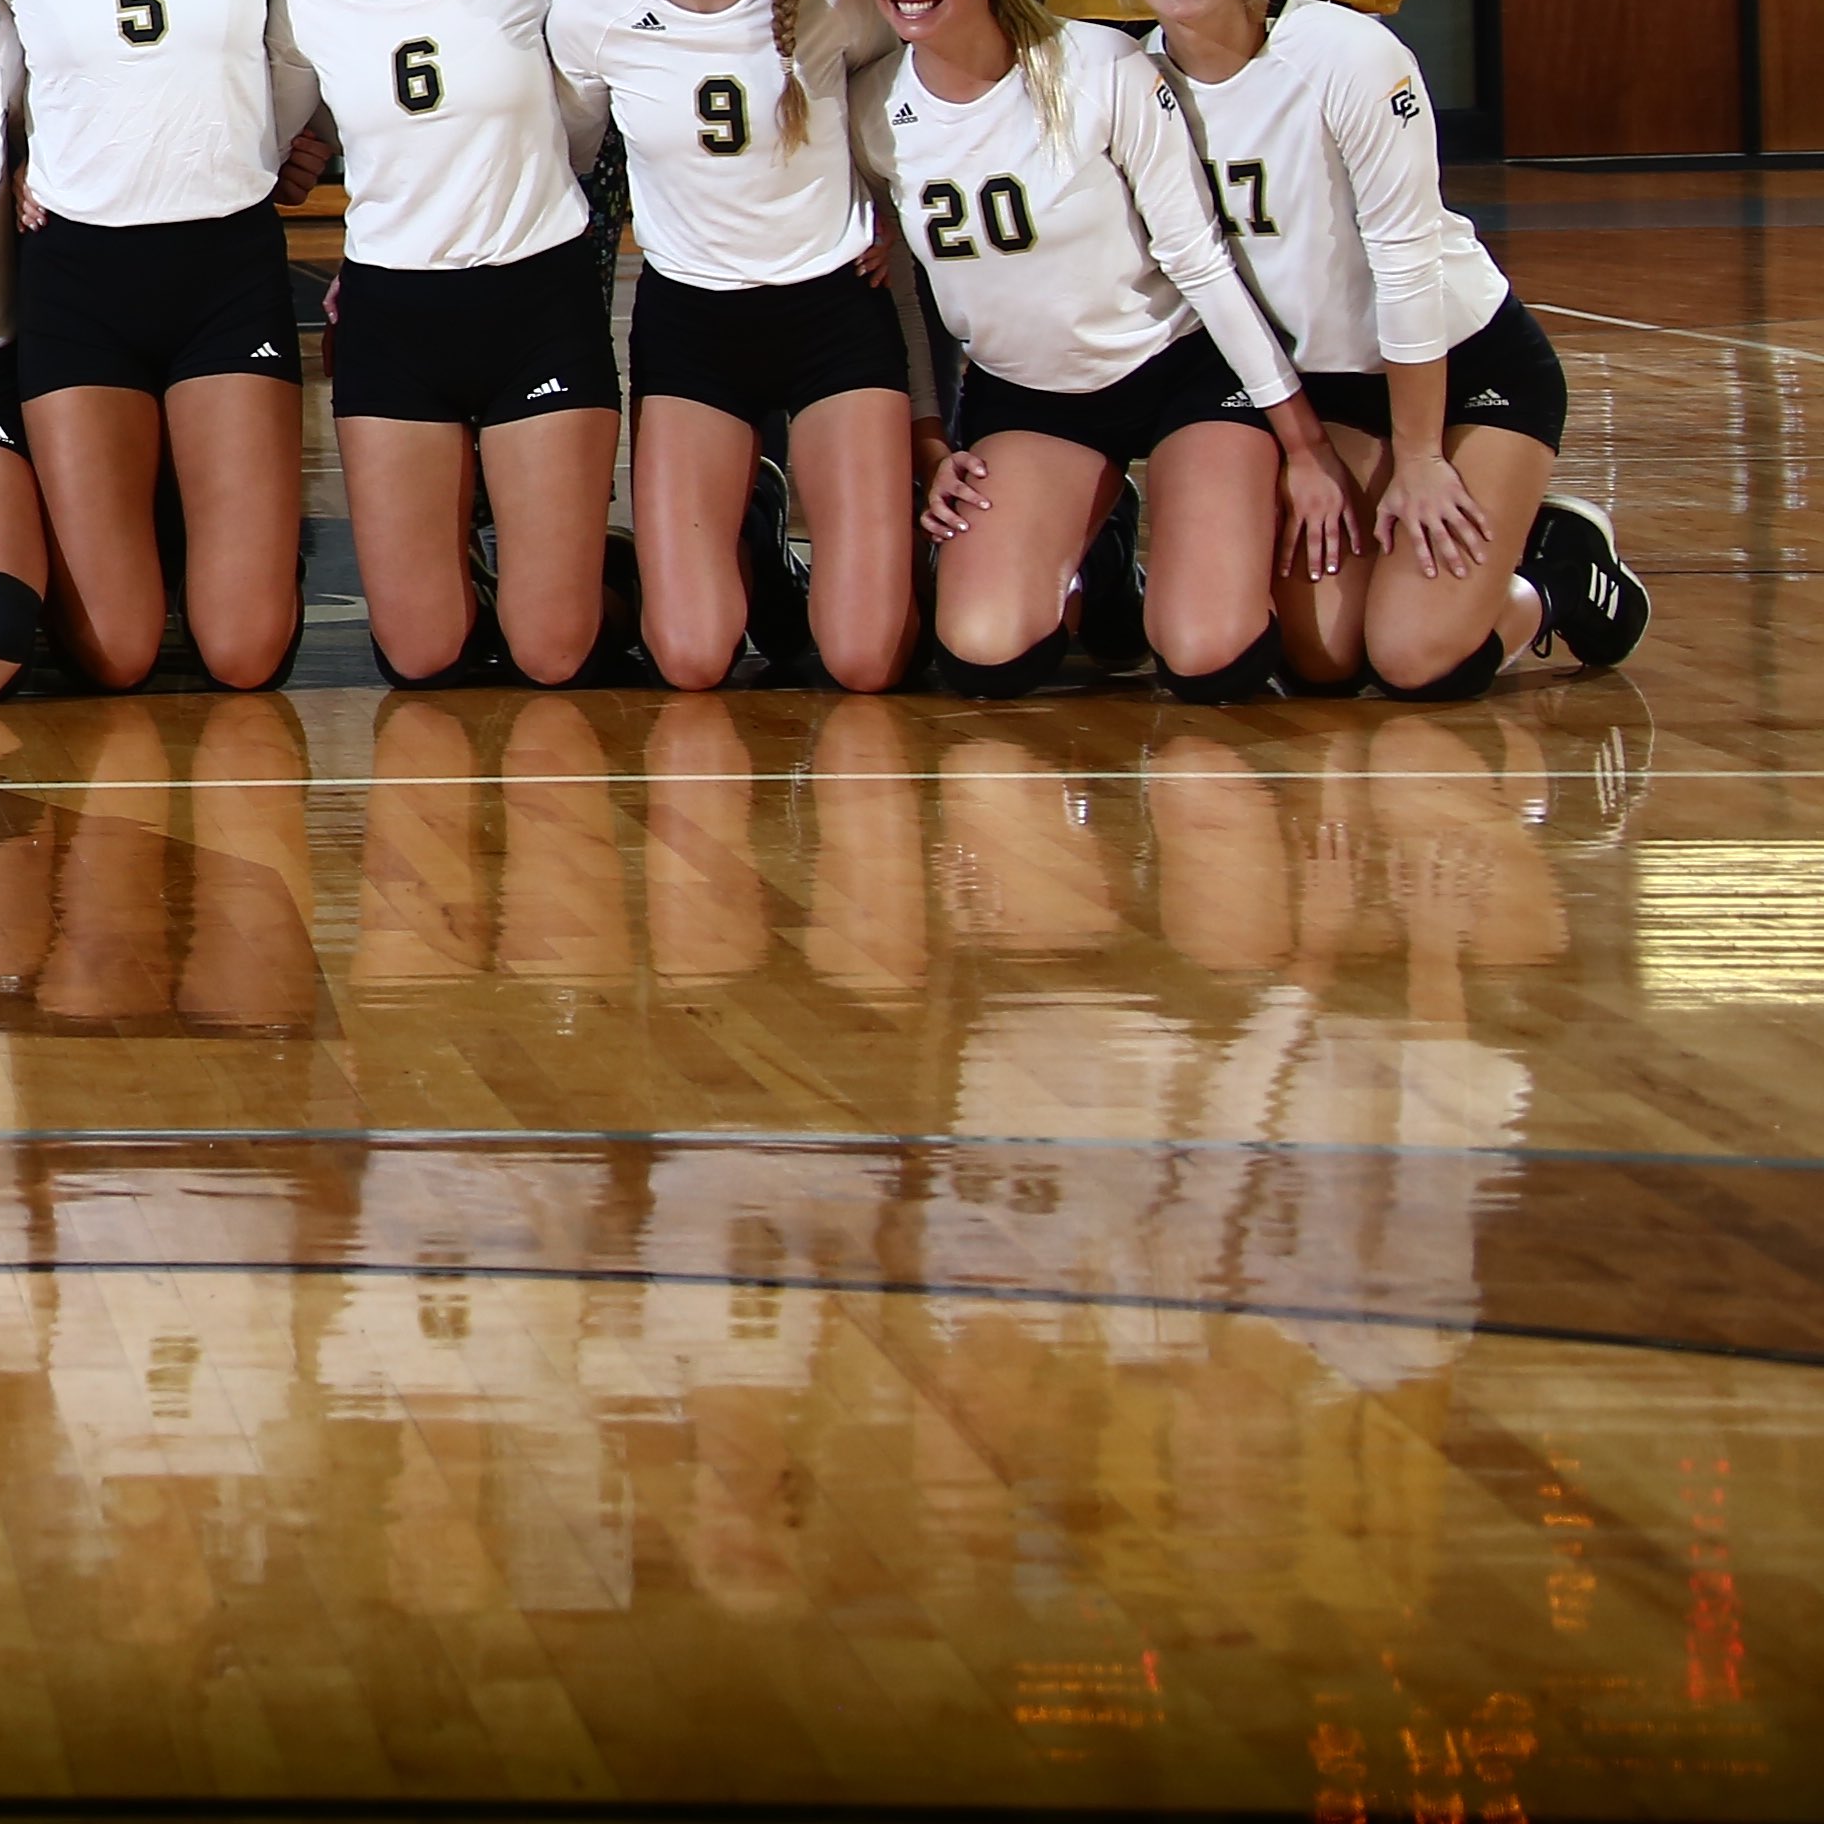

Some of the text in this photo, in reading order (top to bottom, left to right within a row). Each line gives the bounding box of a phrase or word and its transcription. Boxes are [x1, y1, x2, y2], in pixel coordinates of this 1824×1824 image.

[390, 36, 445, 116] 6
[694, 74, 751, 156] 9
[920, 172, 1039, 261] 20
